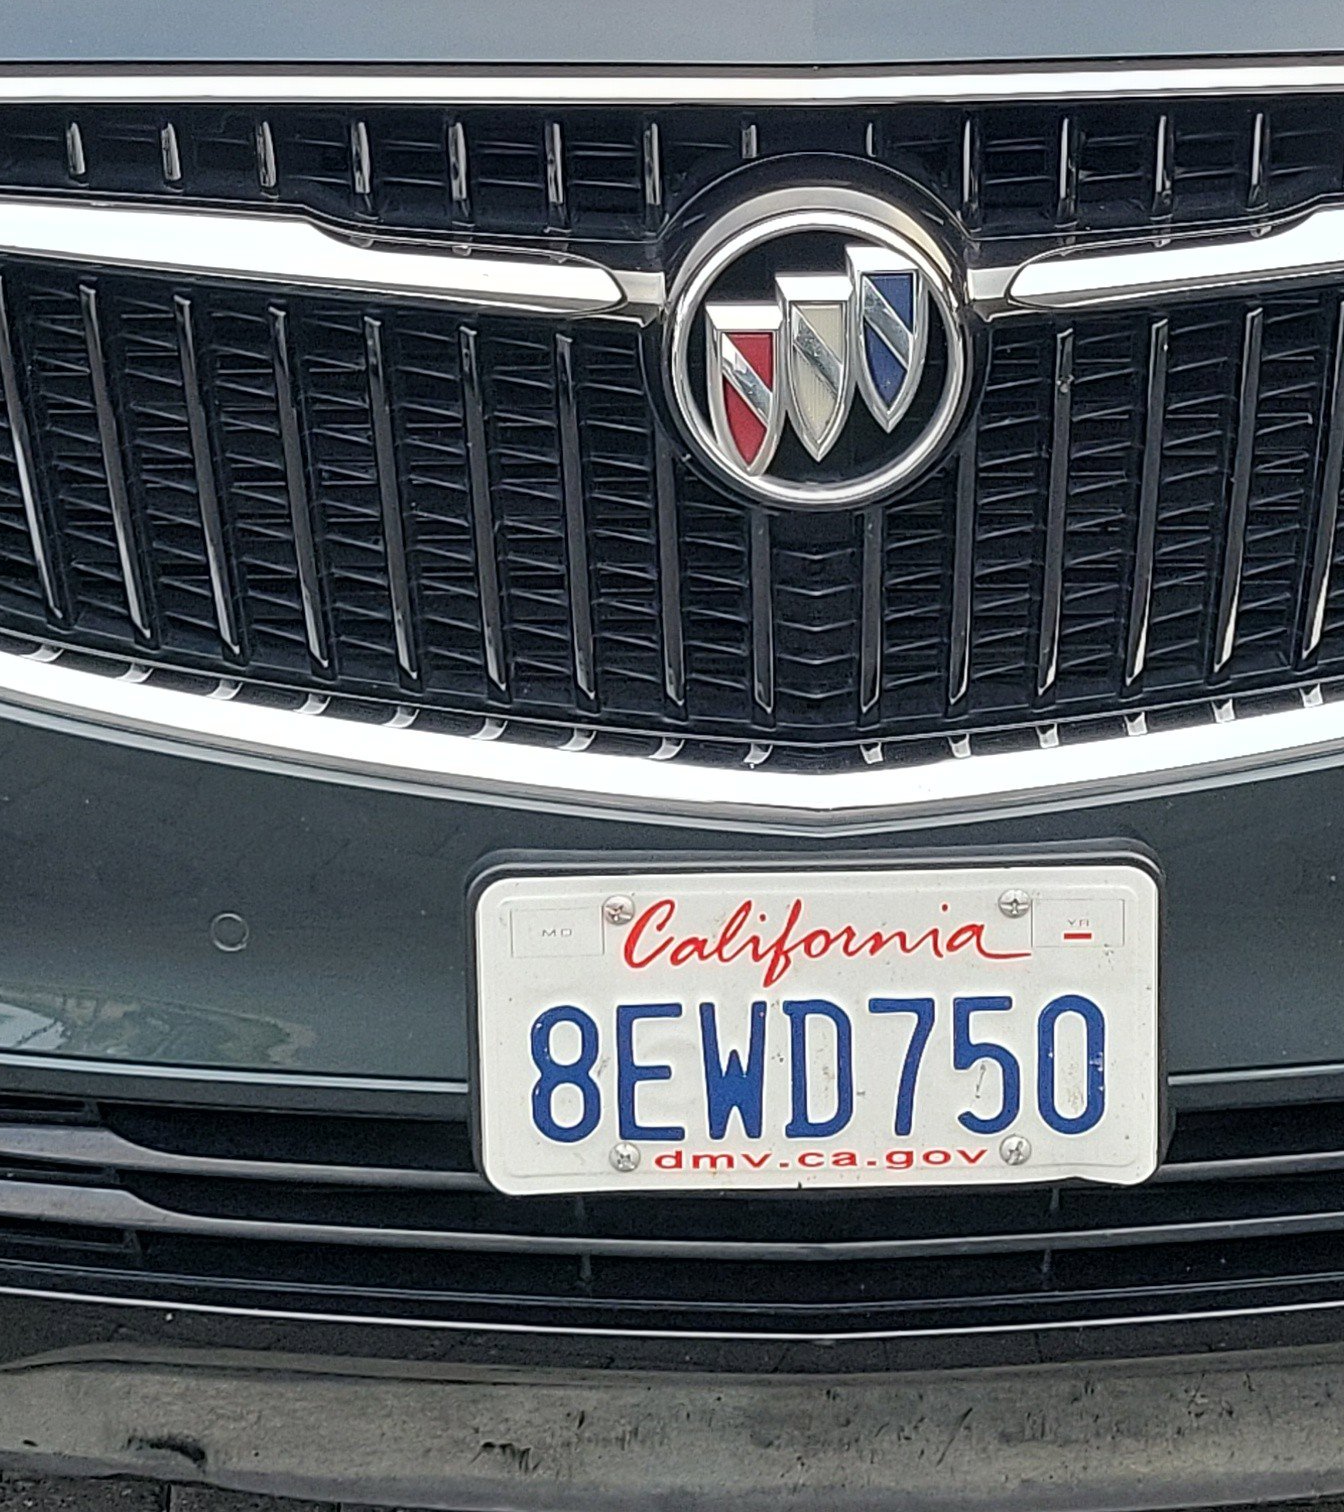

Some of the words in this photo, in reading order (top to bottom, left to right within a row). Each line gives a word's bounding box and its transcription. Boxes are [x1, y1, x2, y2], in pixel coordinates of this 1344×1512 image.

[541, 928, 573, 938] MO
[623, 898, 1033, 987] California
[530, 994, 1107, 1143] 8EWD750
[654, 1146, 989, 1171] dmv.ca.gov
